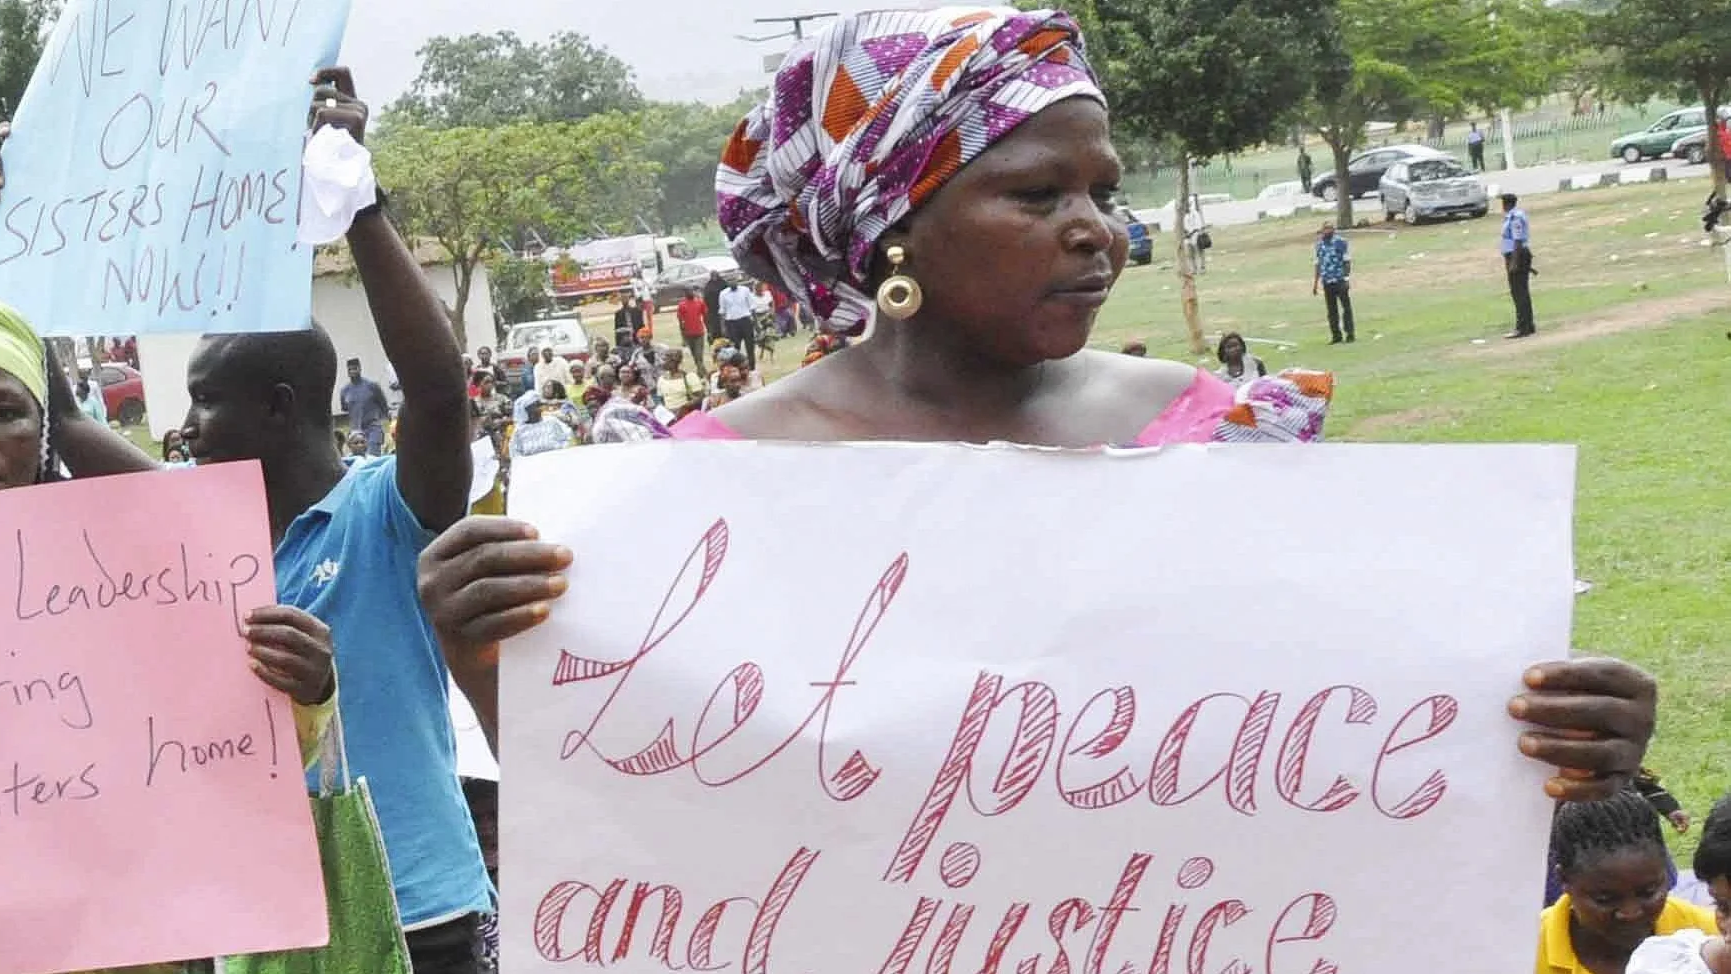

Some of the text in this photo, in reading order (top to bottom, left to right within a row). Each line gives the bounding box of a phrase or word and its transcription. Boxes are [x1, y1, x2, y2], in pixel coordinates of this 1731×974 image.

[100, 81, 231, 170] OUR
[14, 529, 261, 637] Leadership
[145, 699, 280, 787] home!
[552, 515, 1459, 884] Let peace
